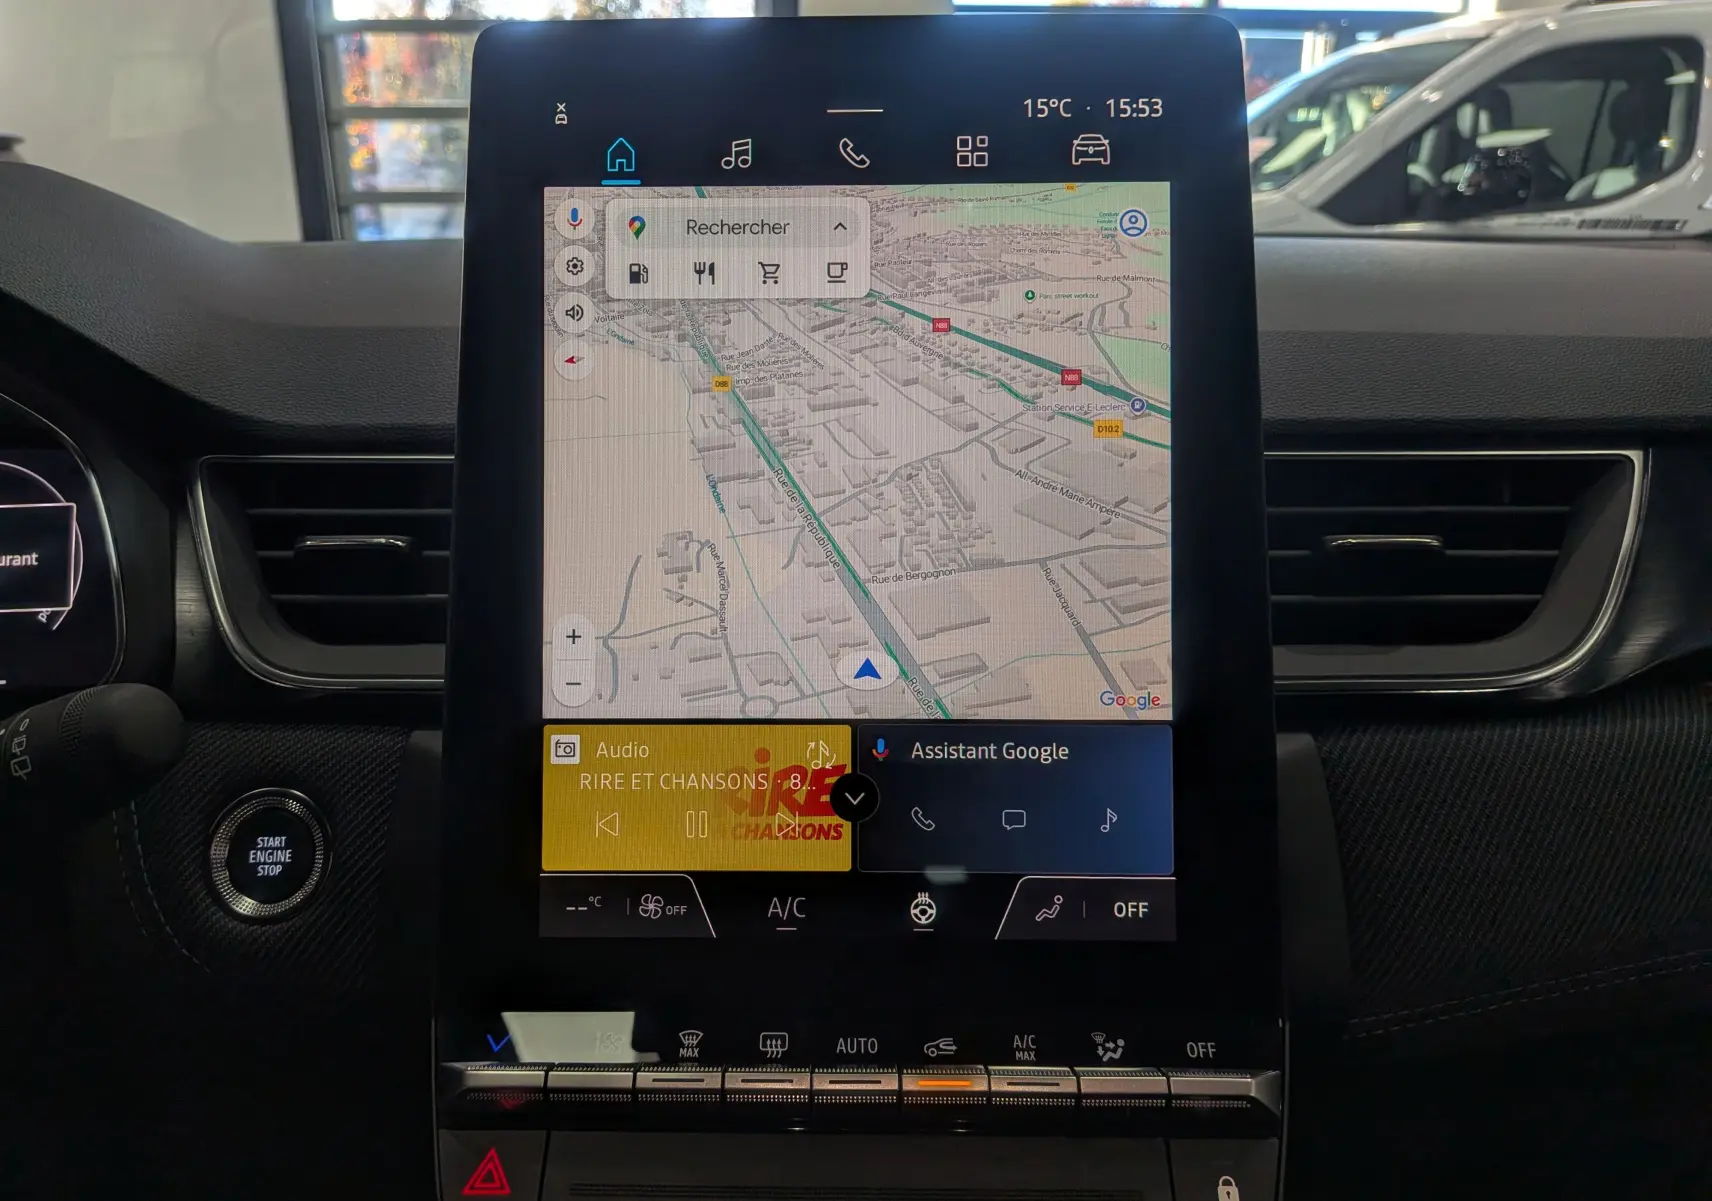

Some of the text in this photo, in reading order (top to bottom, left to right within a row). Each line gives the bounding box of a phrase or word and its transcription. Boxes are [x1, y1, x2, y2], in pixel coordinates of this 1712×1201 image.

[1023, 98, 1163, 118] 15°C 15:53
[686, 218, 790, 236] Rechercher
[1112, 274, 1121, 282] de
[1123, 274, 1156, 283] Malmont
[892, 291, 908, 300] Paul
[910, 287, 942, 299] Langevin
[638, 304, 653, 317] Zola
[688, 317, 710, 360] République
[777, 332, 792, 345] Rue
[790, 339, 802, 352] des
[721, 353, 735, 362] Rue
[736, 348, 754, 359] Jean
[725, 362, 740, 371] Rue
[741, 361, 755, 370] des
[715, 380, 729, 388] D88
[754, 375, 768, 383] des
[769, 370, 803, 381] Platanes
[1022, 403, 1053, 412] Station
[1054, 403, 1086, 412] Service
[1097, 425, 1120, 433] D10.2
[706, 473, 726, 514] L'Ondaine
[1015, 469, 1121, 519] All. André Marie Ampère
[773, 467, 841, 570] Rue de la République
[871, 568, 956, 585] Rue de Bergognon
[707, 543, 730, 633] Rue Marcel Dassault
[1043, 567, 1081, 627] Rue Jacquard
[907, 677, 924, 698] Rue
[922, 698, 934, 712] de
[1099, 690, 1161, 710] Google
[596, 741, 650, 758] Audio
[911, 741, 1069, 764] Assistant Google
[580, 773, 625, 790] RIRE
[632, 773, 655, 790] ET
[660, 773, 768, 790] CHANSONS
[256, 836, 287, 848] START
[249, 849, 293, 863] ENGINE
[257, 864, 283, 877] STOP
[666, 905, 687, 916] OFF
[767, 897, 806, 920] A/C
[1114, 902, 1149, 918] OFF
[836, 1037, 878, 1055] AUTO
[1013, 1034, 1037, 1050] A/C
[1187, 1042, 1217, 1059] OFF
[679, 1048, 700, 1058] MAX
[1015, 1051, 1036, 1061] MAX
